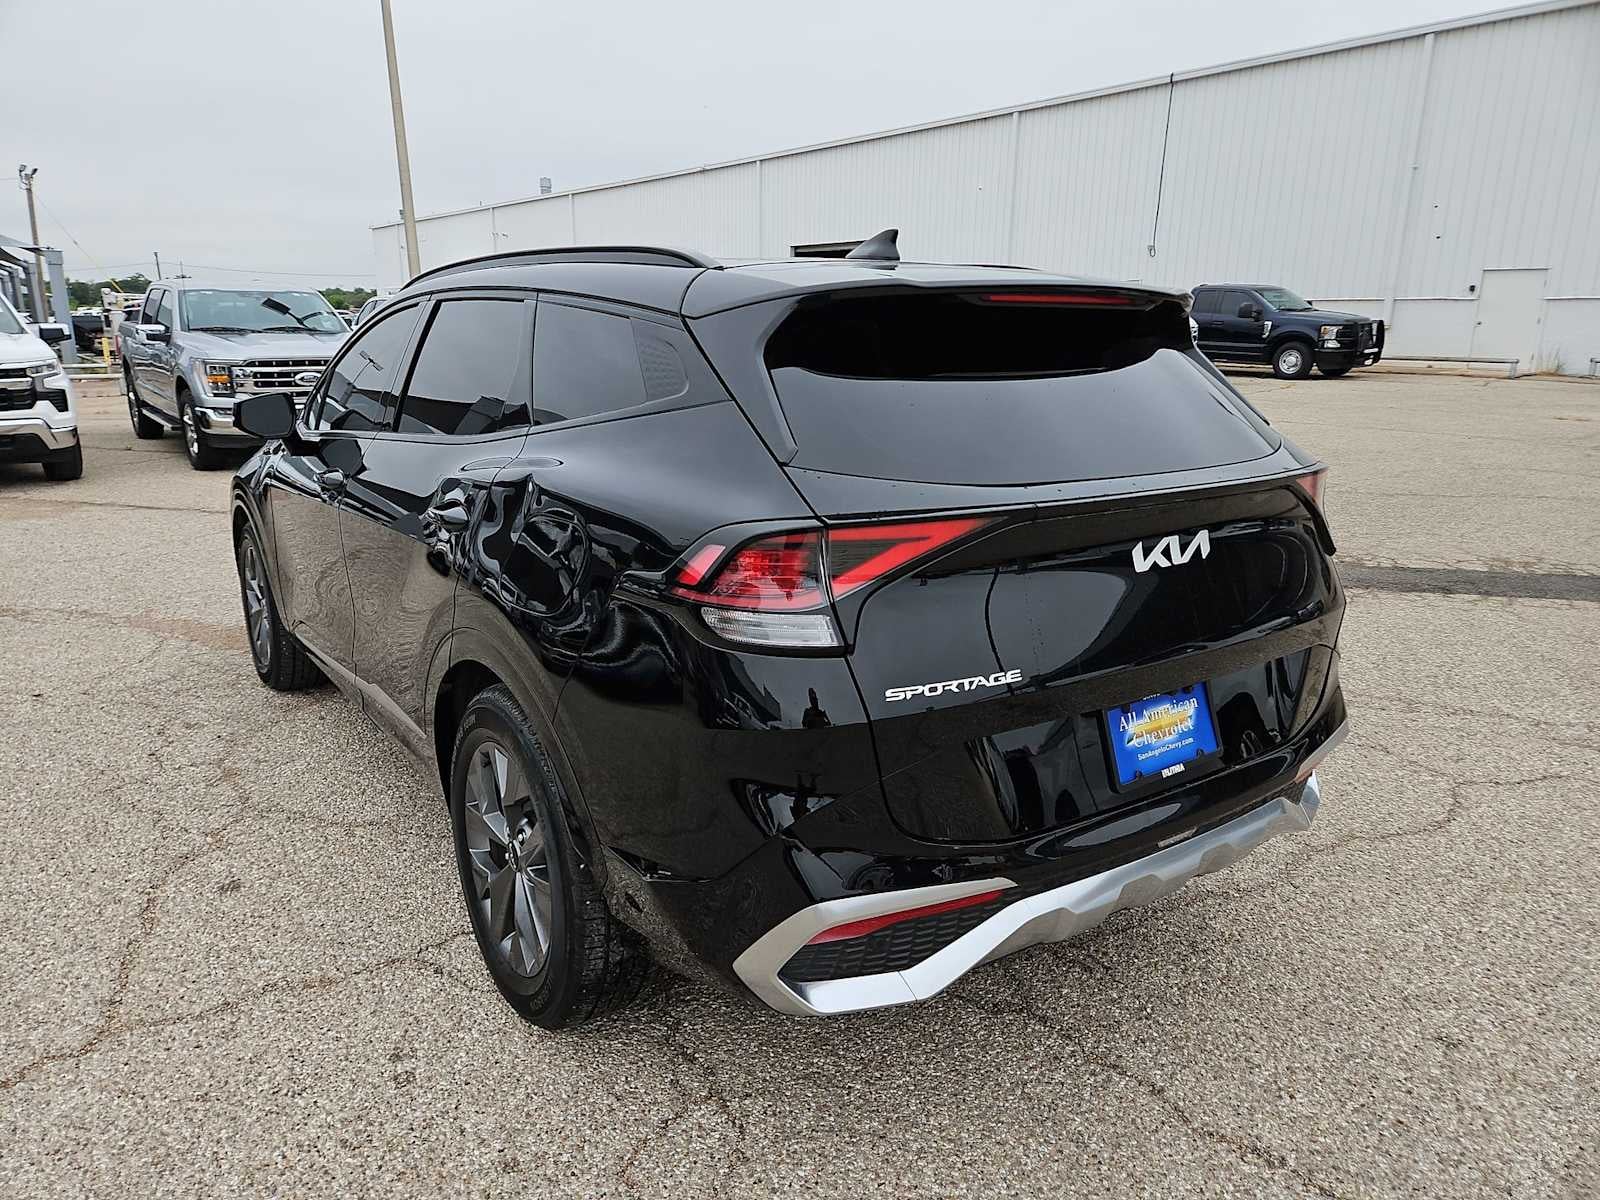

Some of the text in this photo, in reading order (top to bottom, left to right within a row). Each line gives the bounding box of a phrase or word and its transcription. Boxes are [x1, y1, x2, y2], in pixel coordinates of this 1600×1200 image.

[1131, 529, 1211, 573] KIA
[885, 669, 1023, 702] SPORTAGE
[1119, 697, 1199, 732] All American
[1133, 717, 1194, 747] Chevrolet
[1137, 738, 1194, 761] SanAngeloChevy.com
